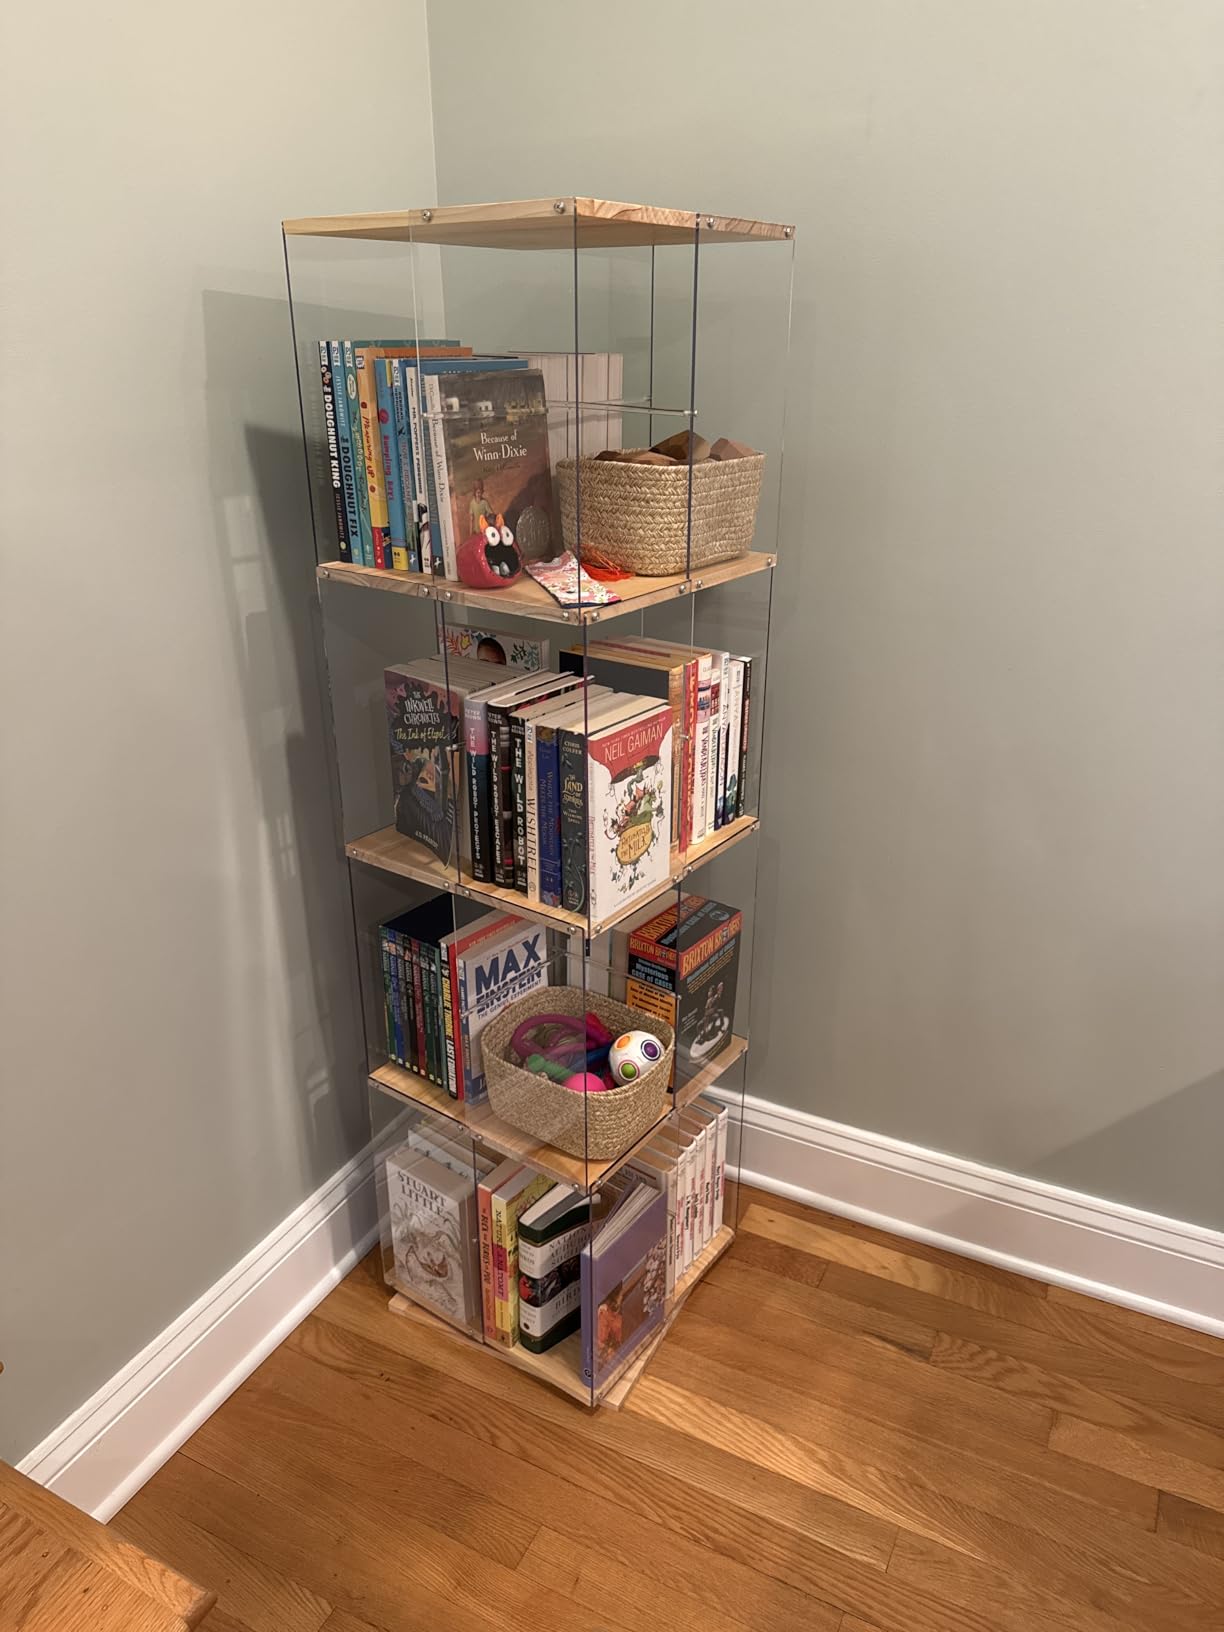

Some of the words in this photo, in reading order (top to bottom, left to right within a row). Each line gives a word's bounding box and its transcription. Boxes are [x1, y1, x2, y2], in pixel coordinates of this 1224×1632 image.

[324, 394, 337, 457] DOUGHNUT
[361, 415, 373, 461] Measuring
[431, 418, 441, 448] Because
[480, 432, 508, 444] Because
[511, 429, 518, 440] of
[473, 444, 528, 461] Winn-Dixie
[330, 459, 340, 488] KING
[341, 446, 355, 516] DOUGHNUT
[349, 518, 357, 537] FIX
[404, 698, 434, 712] INKWELL
[404, 712, 440, 725] CHRONICLES
[395, 728, 407, 740] The
[408, 728, 419, 740] Ink
[604, 741, 625, 763] NEIL
[627, 723, 663, 753] GAIMAN
[514, 737, 522, 767] THE
[514, 773, 524, 812] WILD
[517, 816, 525, 865] ROBOT
[526, 797, 536, 875] WISHTREE
[639, 906, 678, 940] BRIXTON
[630, 938, 655, 955] BRIXTON
[682, 935, 715, 977] BRIXTON
[475, 933, 541, 998] MAX
[441, 976, 451, 1007] CHARLIE
[511, 979, 541, 1000] EXPERIMENT
[443, 1008, 453, 1038] THORNE
[446, 1039, 454, 1058] LAST
[398, 1171, 447, 1207] STUART
[402, 1184, 445, 1219] LITTLE
[495, 1209, 503, 1248] NATURE
[496, 1253, 505, 1296] ANATOMY
